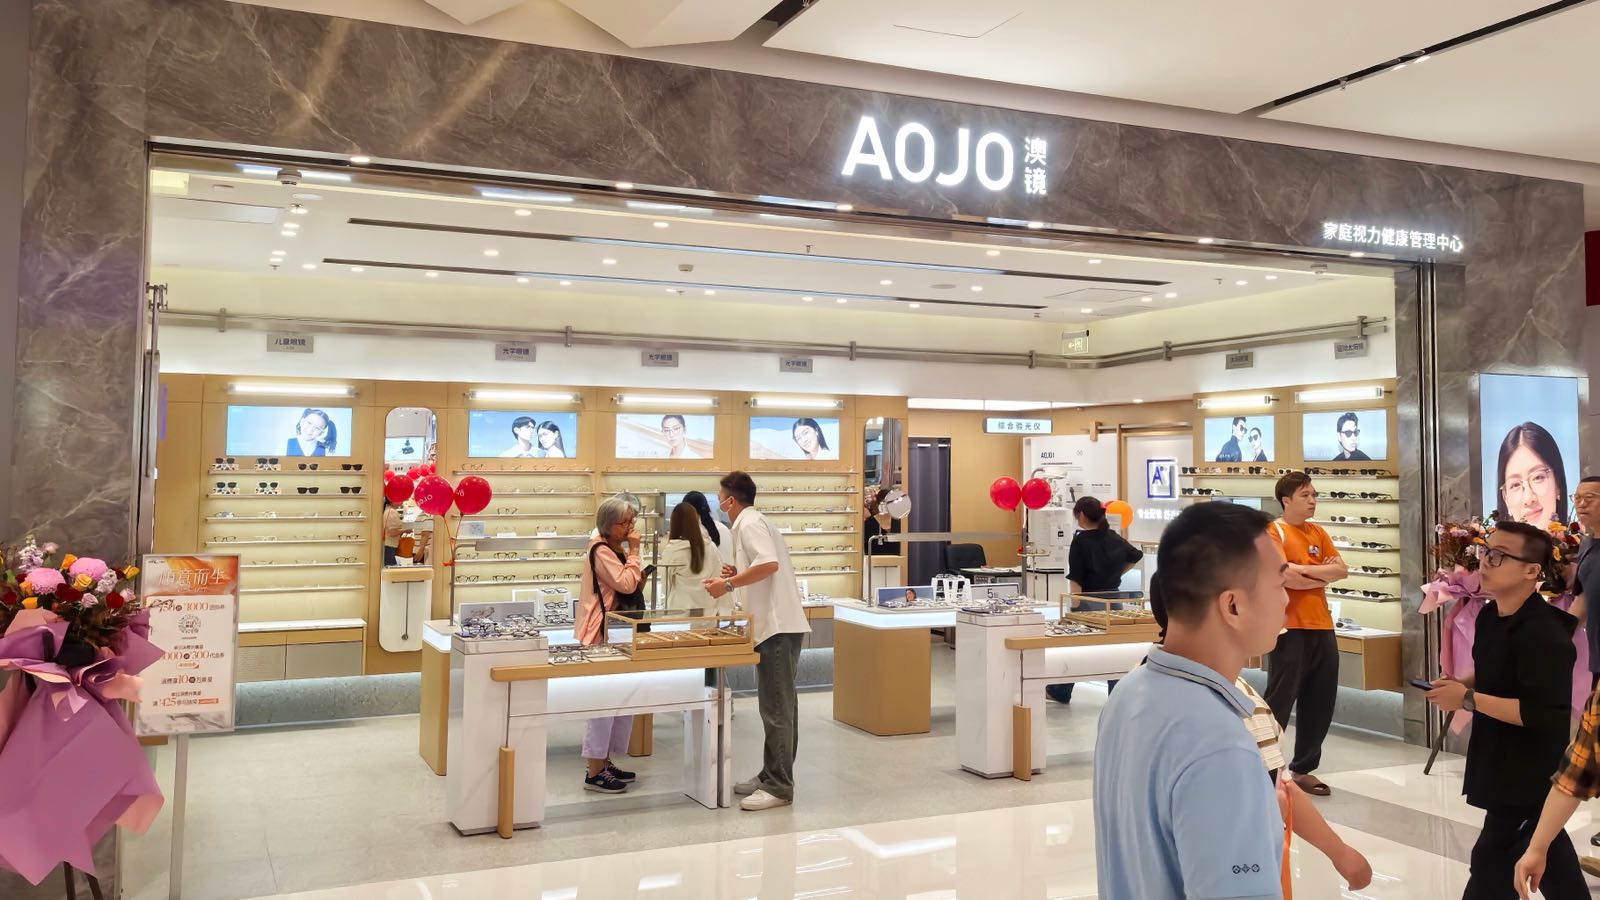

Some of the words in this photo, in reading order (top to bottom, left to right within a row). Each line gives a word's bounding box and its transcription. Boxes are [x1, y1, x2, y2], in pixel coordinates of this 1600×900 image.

[840, 114, 1014, 192] AOJO
[1023, 136, 1048, 196] 澳镜
[1322, 221, 1465, 254] 家庭视力健康管理中心
